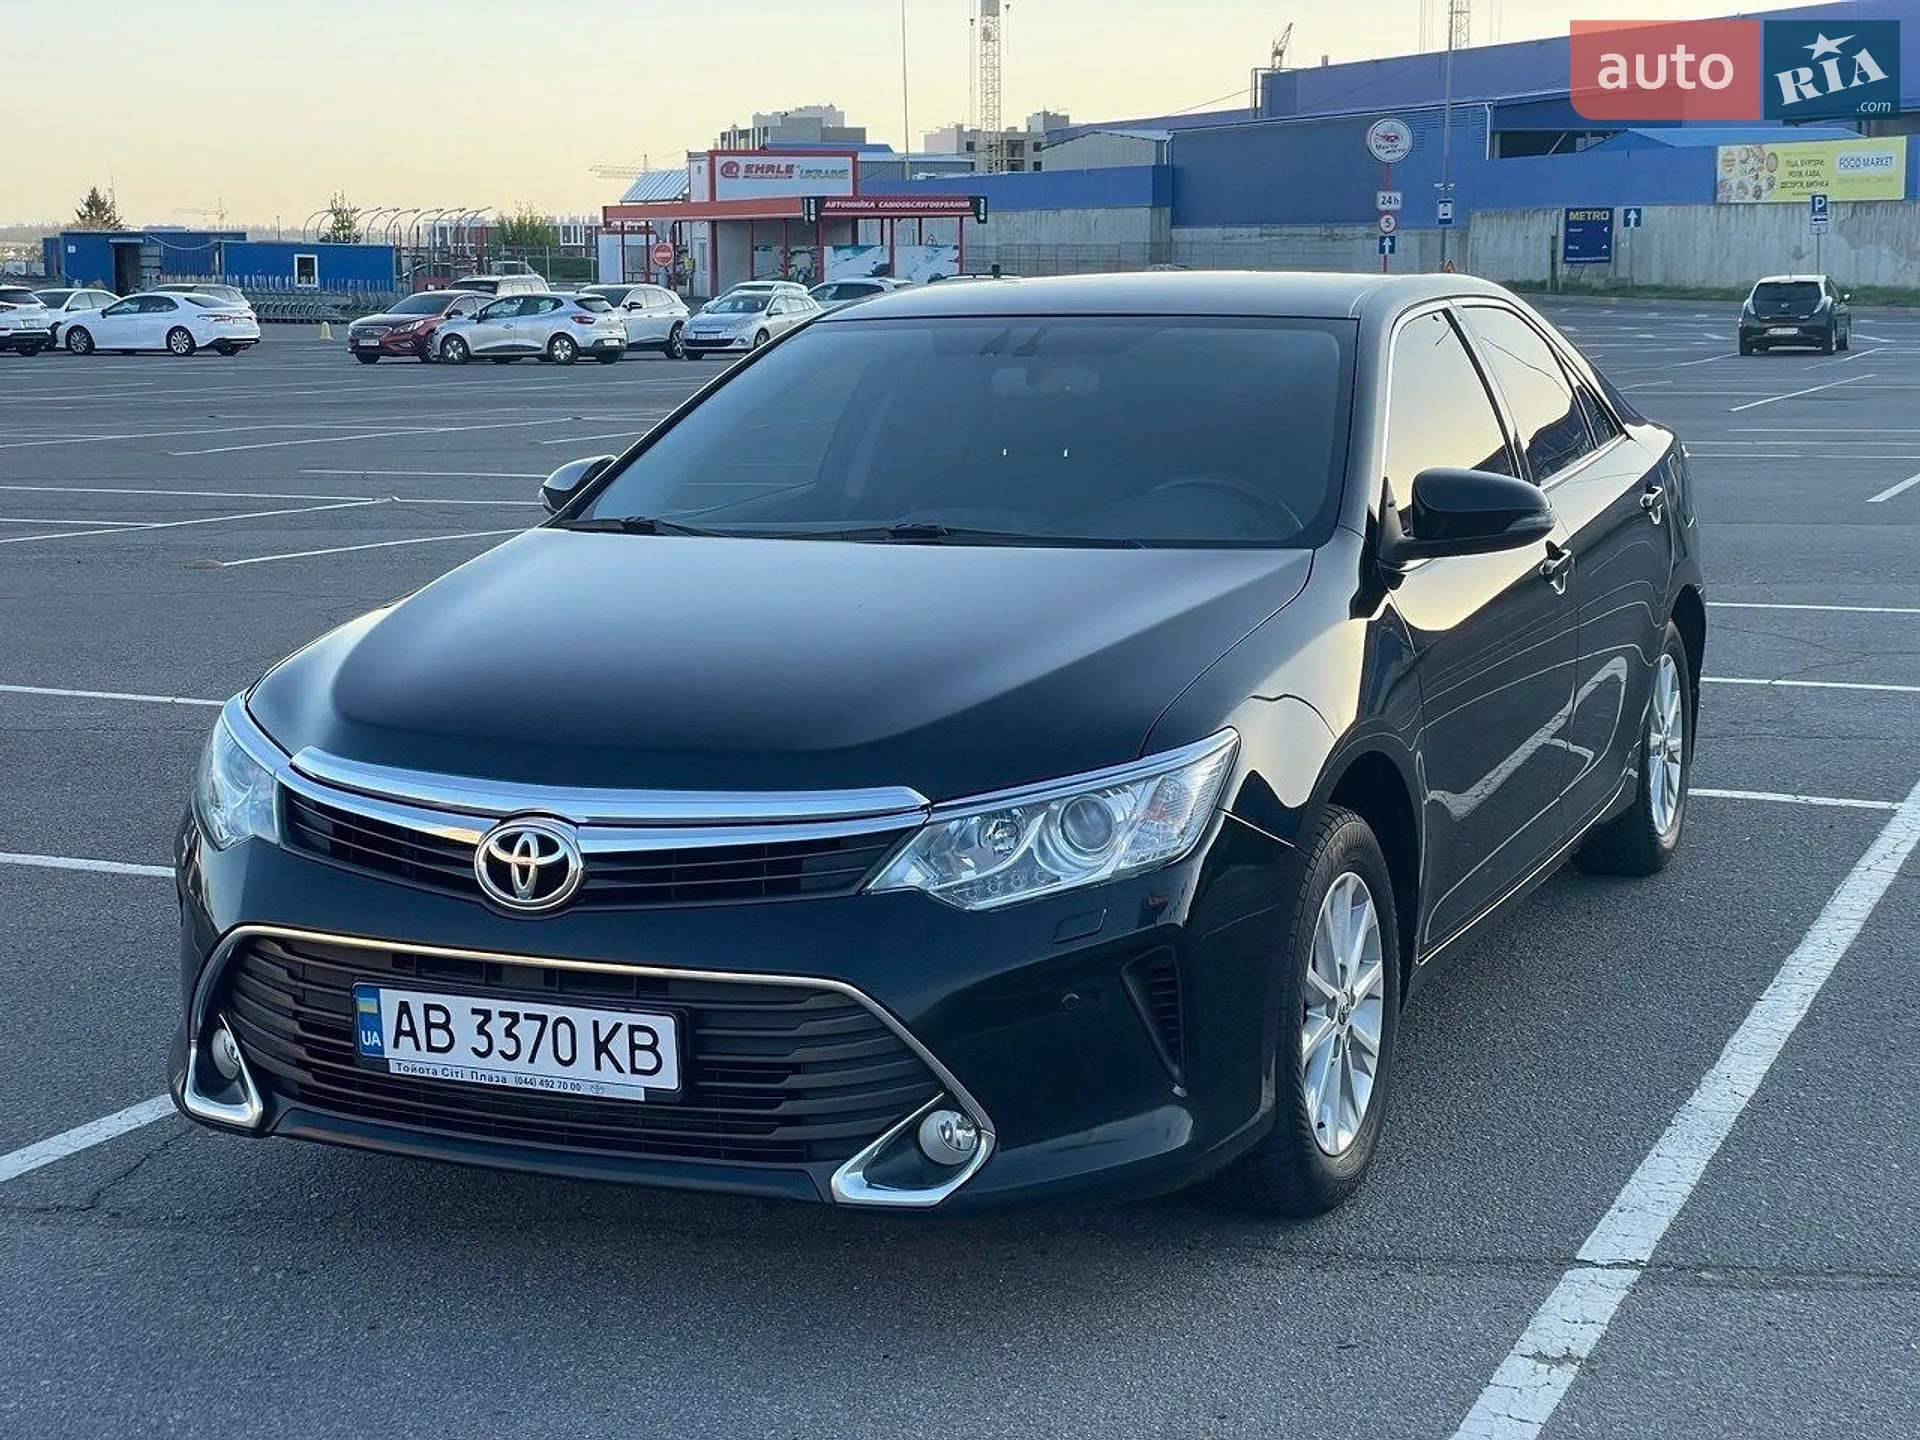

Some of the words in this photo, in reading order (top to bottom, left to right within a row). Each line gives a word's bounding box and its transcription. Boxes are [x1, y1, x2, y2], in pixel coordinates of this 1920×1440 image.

[743, 163, 795, 174] EHRLE
[1862, 155, 1893, 168] MARKET
[1814, 196, 1826, 212] P
[1569, 210, 1609, 221] METRO
[361, 1030, 382, 1047] UA
[392, 999, 456, 1054] AB
[470, 1007, 578, 1067] 3370
[592, 1018, 663, 1077] KB
[396, 1062, 438, 1076] Тойота
[470, 1070, 508, 1085] Плаза
[514, 1076, 537, 1087] (044)
[540, 1078, 555, 1089] 492
[569, 1081, 582, 1092] 00
